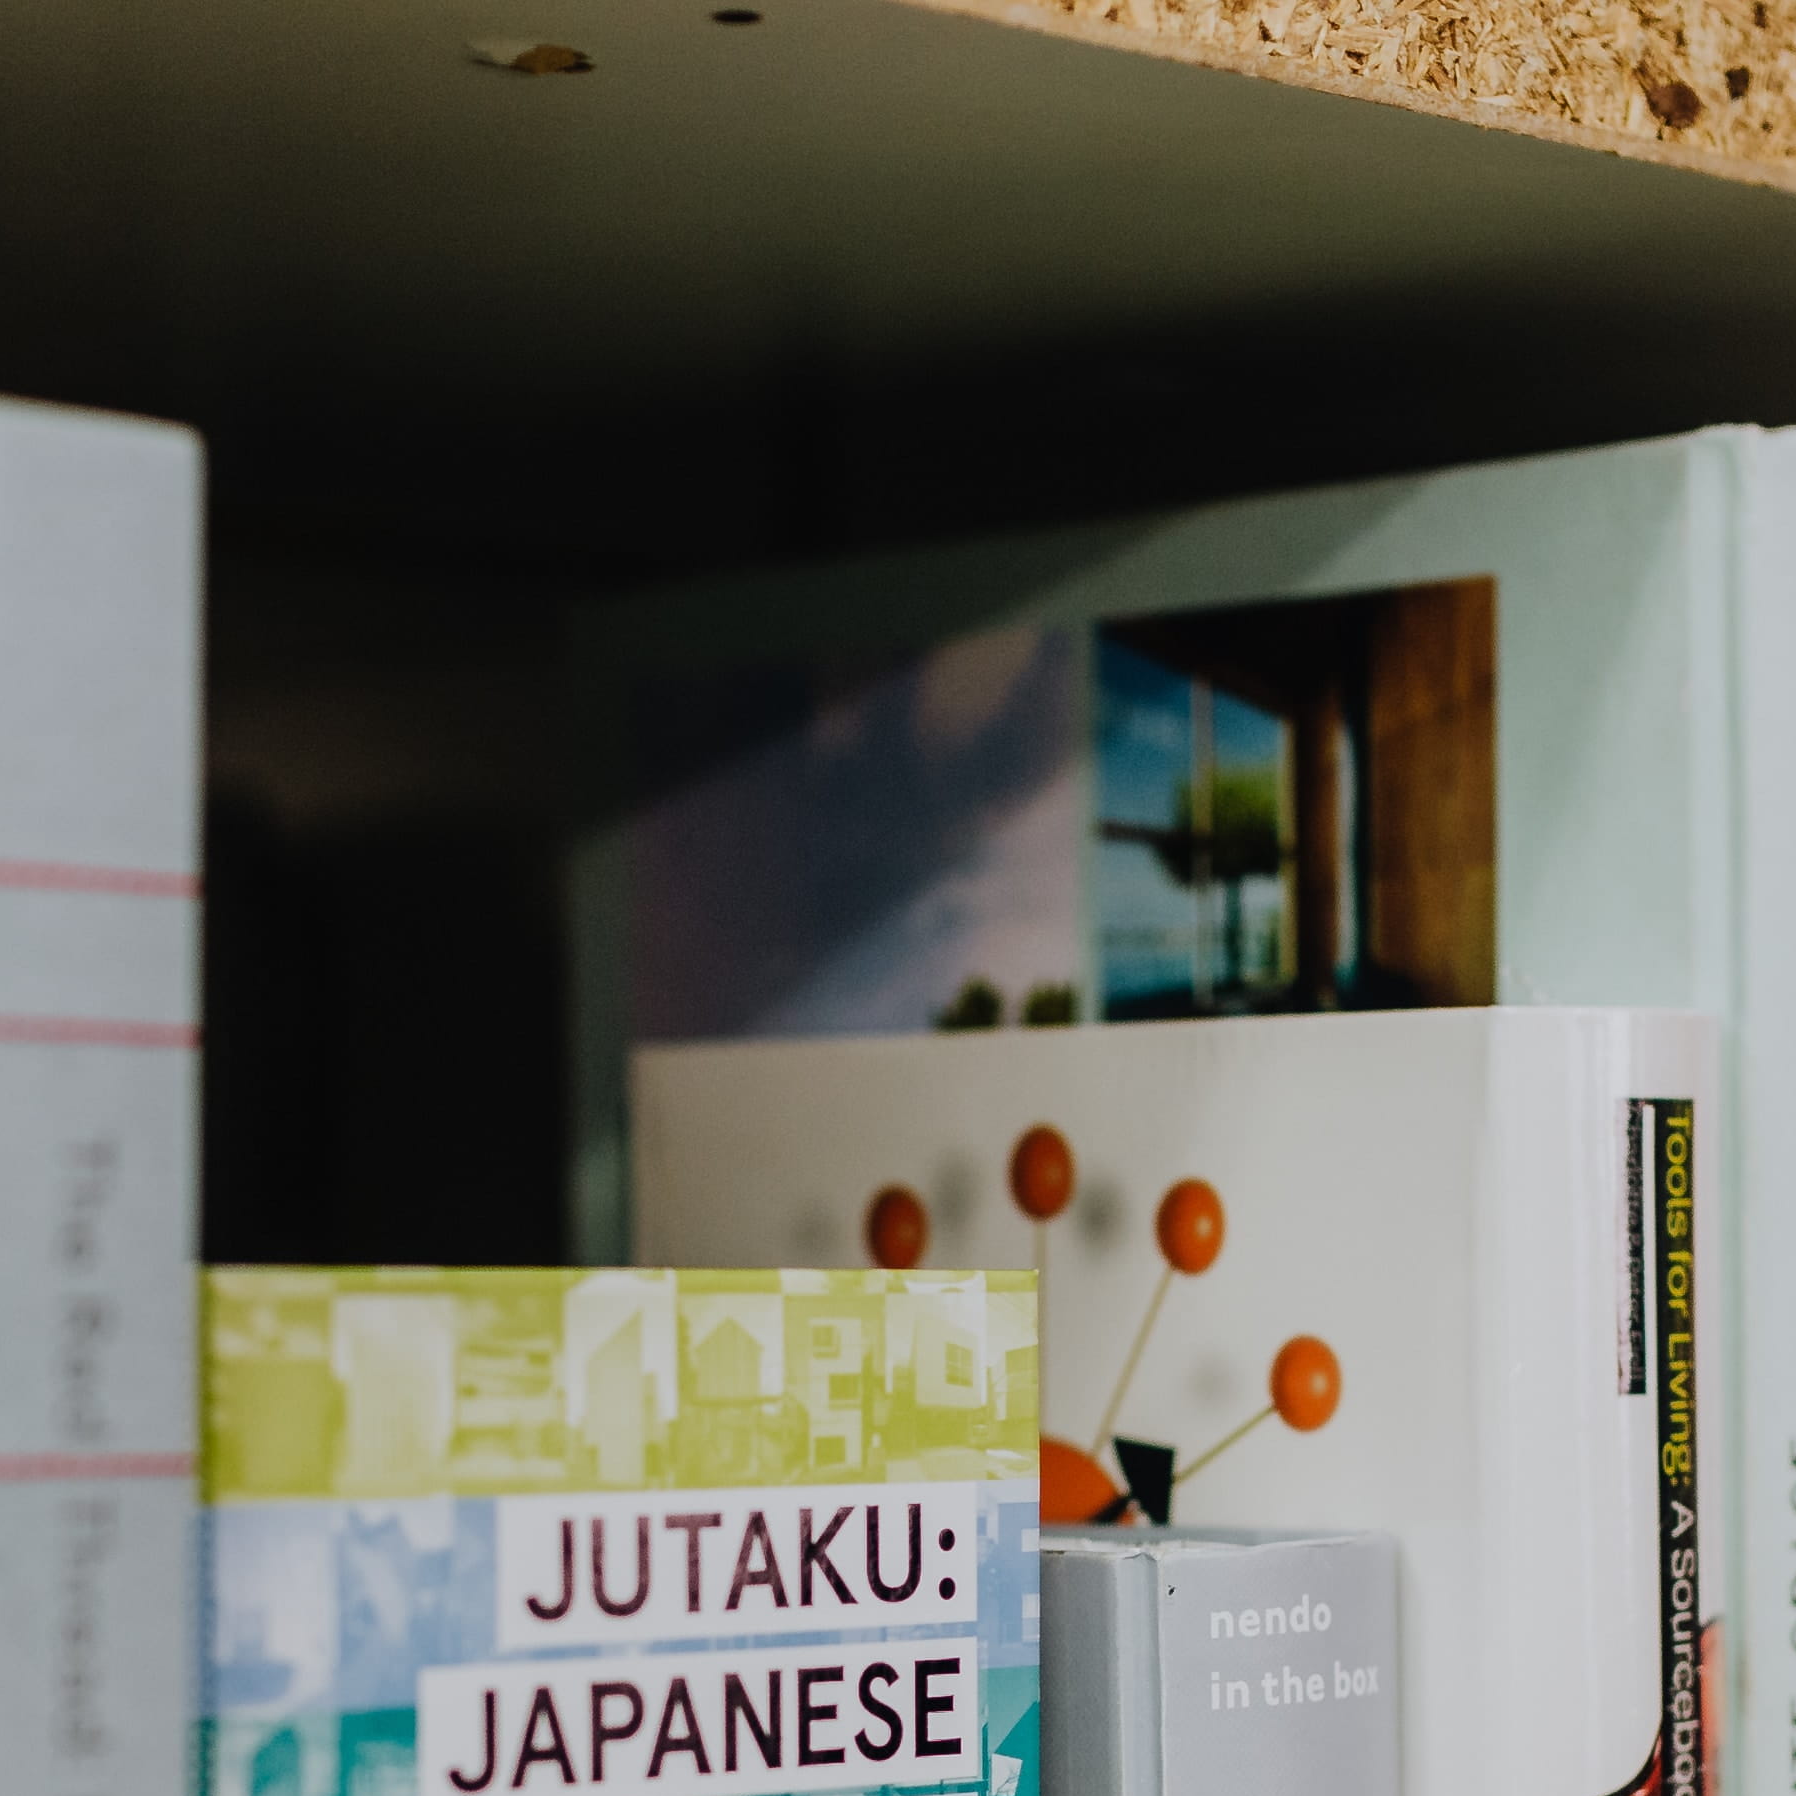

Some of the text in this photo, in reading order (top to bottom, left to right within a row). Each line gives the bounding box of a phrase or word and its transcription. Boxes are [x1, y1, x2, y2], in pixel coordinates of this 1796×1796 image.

[57, 1135, 121, 1272] The
[1665, 1114, 1690, 1239] Tools
[1666, 1250, 1691, 1314] for
[57, 1299, 123, 1444] Red
[1661, 1331, 1694, 1487] Living:
[525, 1502, 958, 1622] JUTAKU:
[1670, 1500, 1695, 1540] A
[1209, 1593, 1333, 1640] nendo
[447, 1656, 964, 1795] JAPANESE
[1209, 1660, 1381, 1711] in the box
